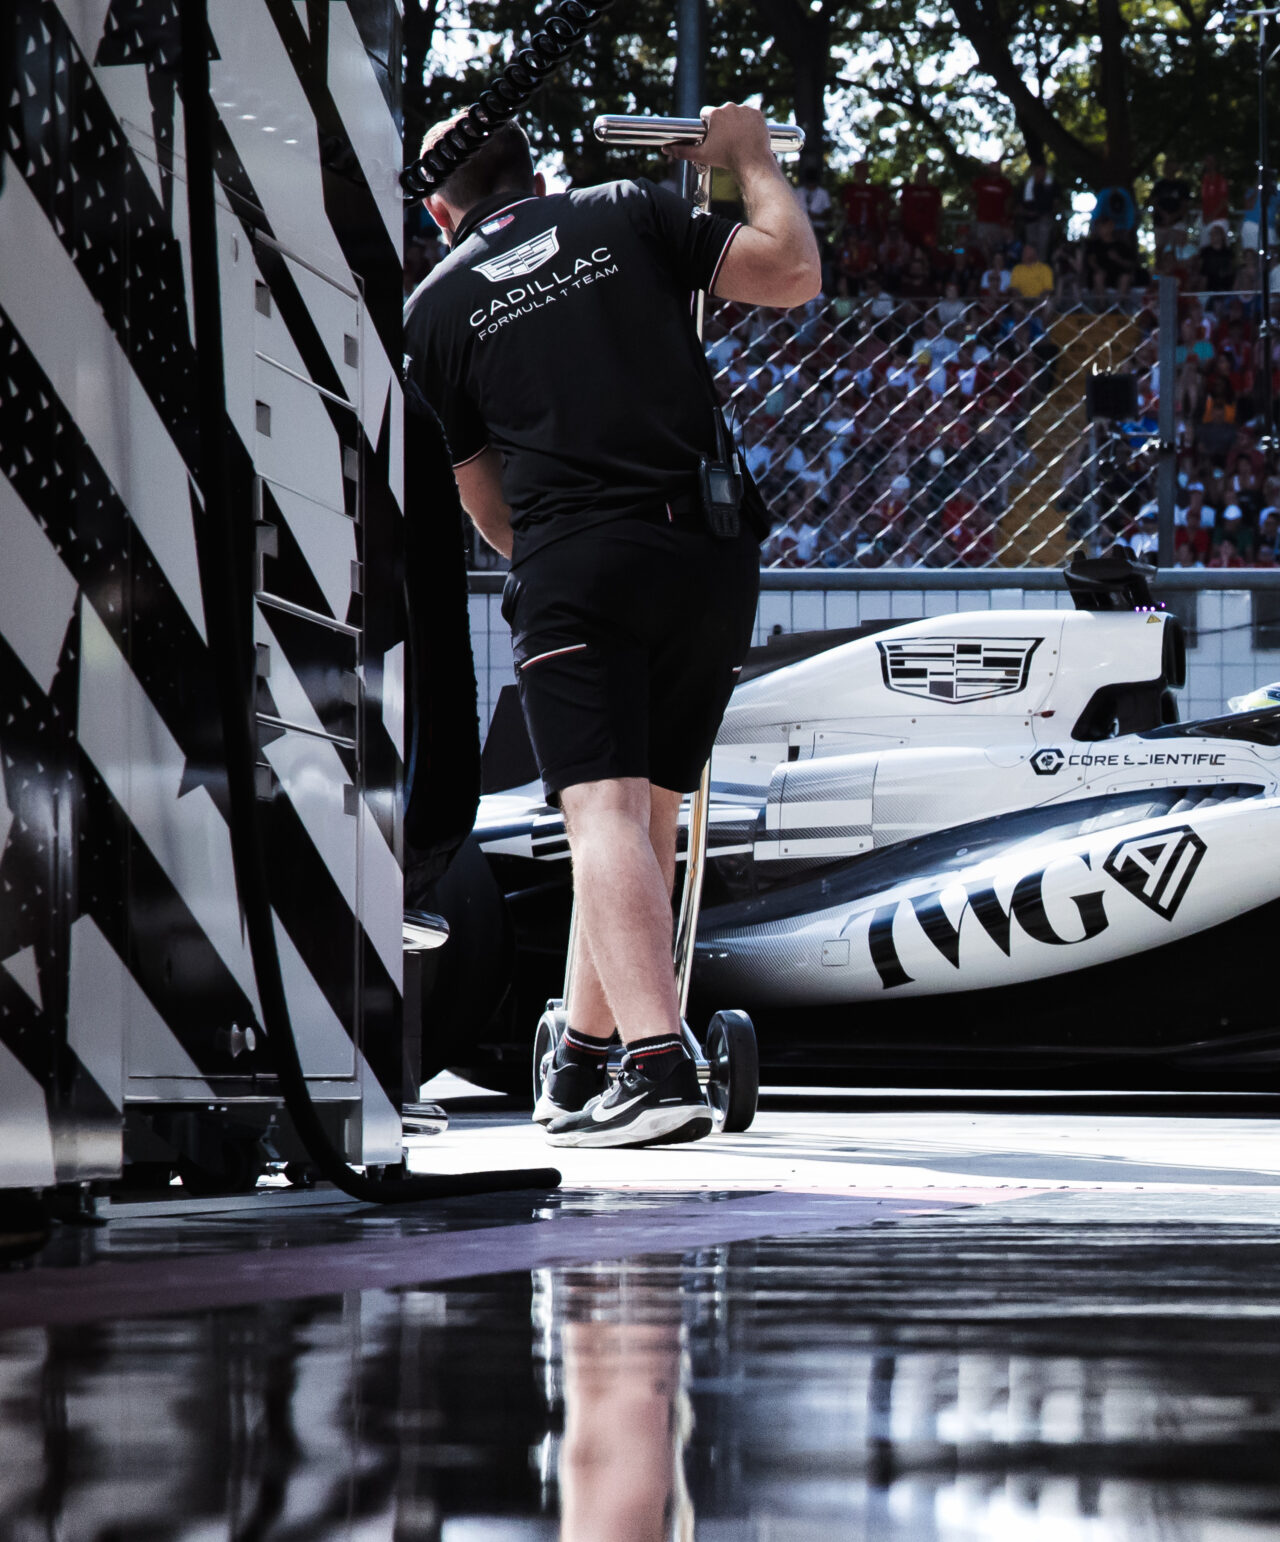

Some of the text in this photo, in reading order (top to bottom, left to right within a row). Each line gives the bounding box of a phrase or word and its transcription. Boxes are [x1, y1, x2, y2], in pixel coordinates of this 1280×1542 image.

[469, 247, 612, 327] CADILLAC
[478, 295, 556, 341] FORMULA
[571, 264, 619, 289] TEAM
[1068, 754, 1119, 766] CORE
[839, 850, 1109, 990] TWG
